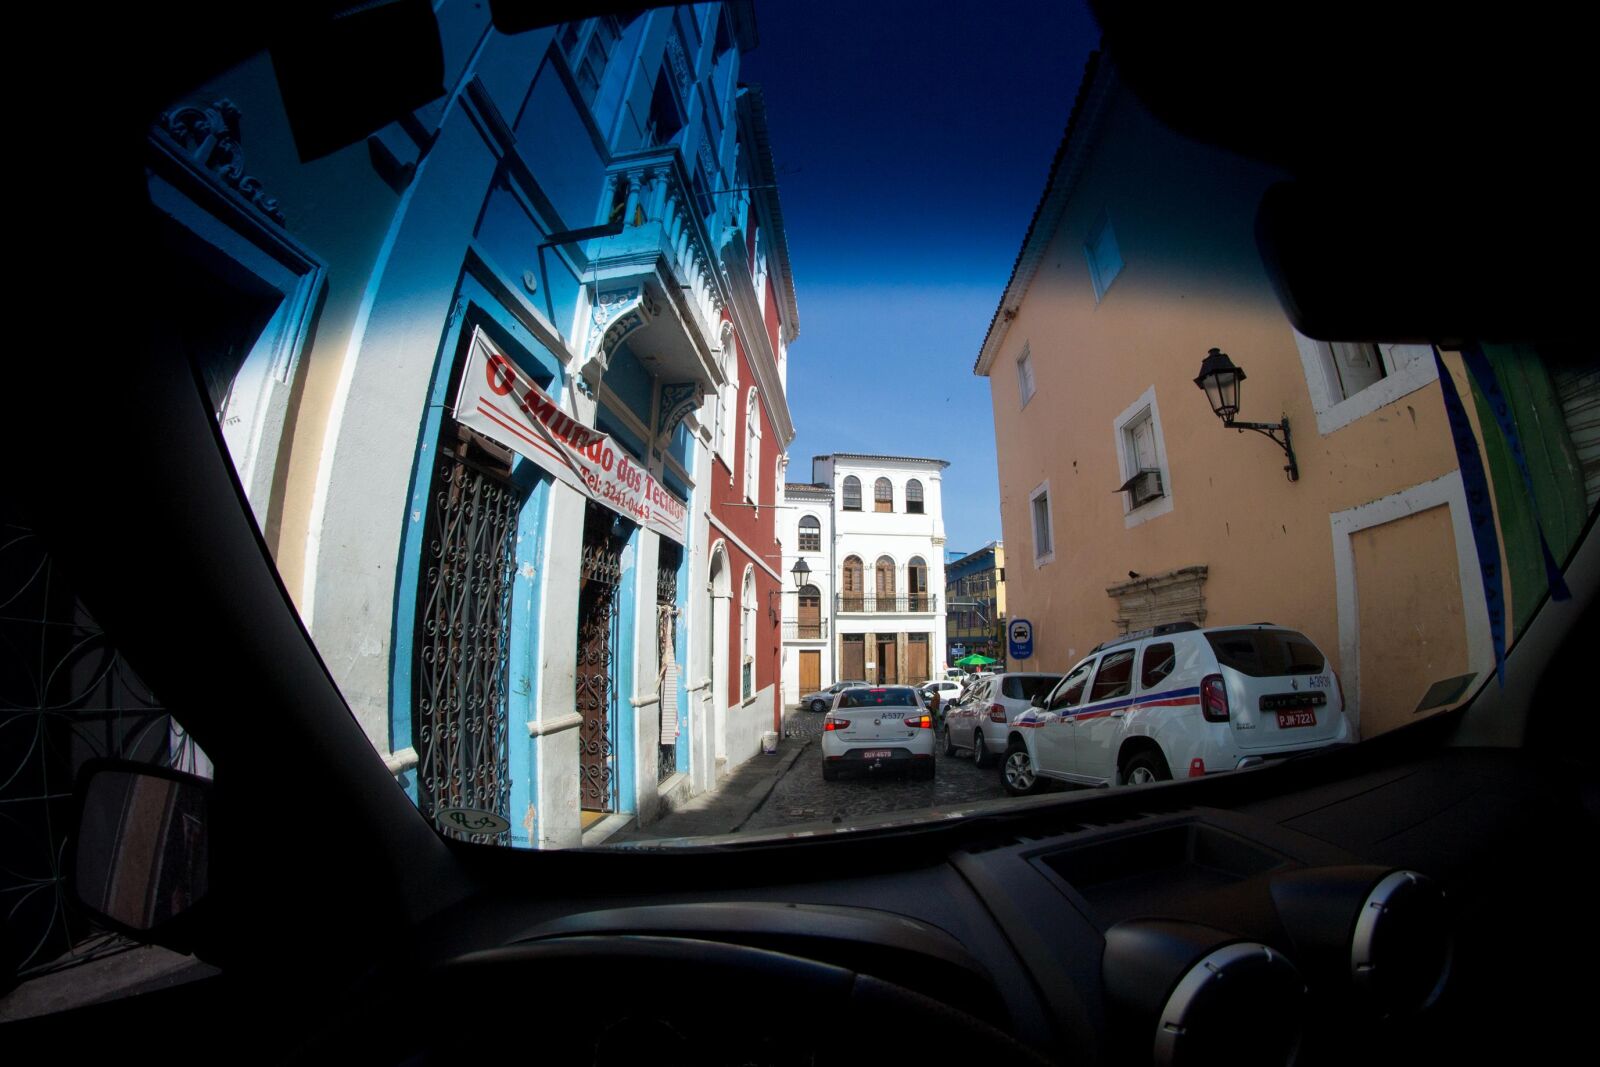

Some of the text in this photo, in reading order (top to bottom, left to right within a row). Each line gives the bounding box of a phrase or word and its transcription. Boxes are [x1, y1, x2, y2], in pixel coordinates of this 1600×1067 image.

[486, 354, 517, 396] O
[521, 390, 614, 471] Mundo
[616, 456, 641, 491] dos
[603, 482, 650, 519] 3241-0443
